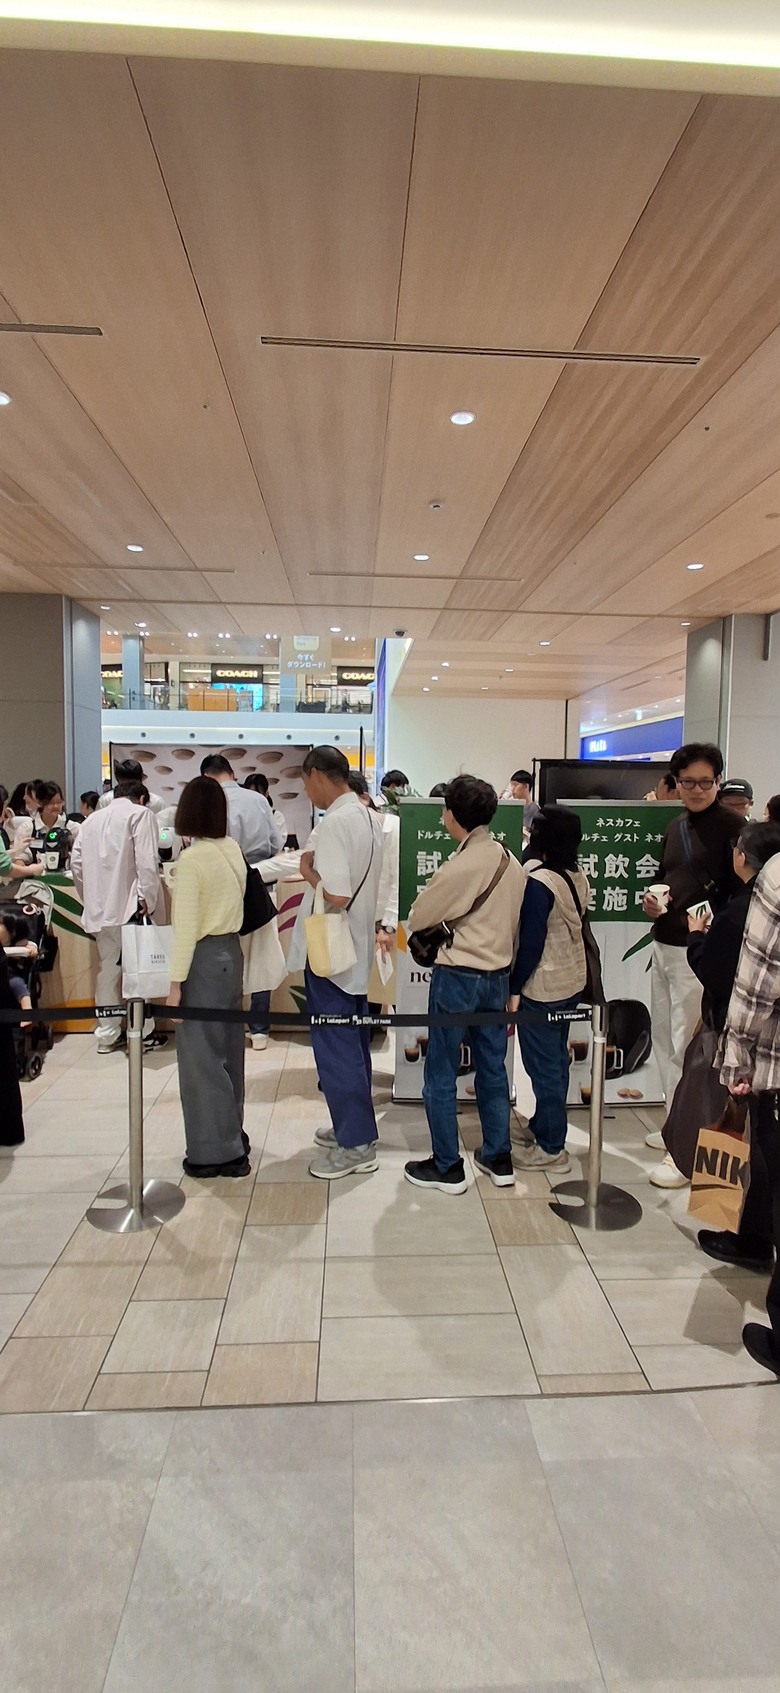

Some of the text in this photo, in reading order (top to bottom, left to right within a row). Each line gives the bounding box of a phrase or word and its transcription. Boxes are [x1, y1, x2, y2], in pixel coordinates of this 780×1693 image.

[296, 653, 315, 661] 今すぐ
[287, 661, 326, 669] ダウンロード!
[215, 669, 258, 678] COACH
[596, 817, 641, 828] ネスカフェ
[417, 829, 452, 841] ドルチェ
[581, 832, 664, 843] ルチェ グスト ネオ
[695, 1145, 749, 1190] NIK
